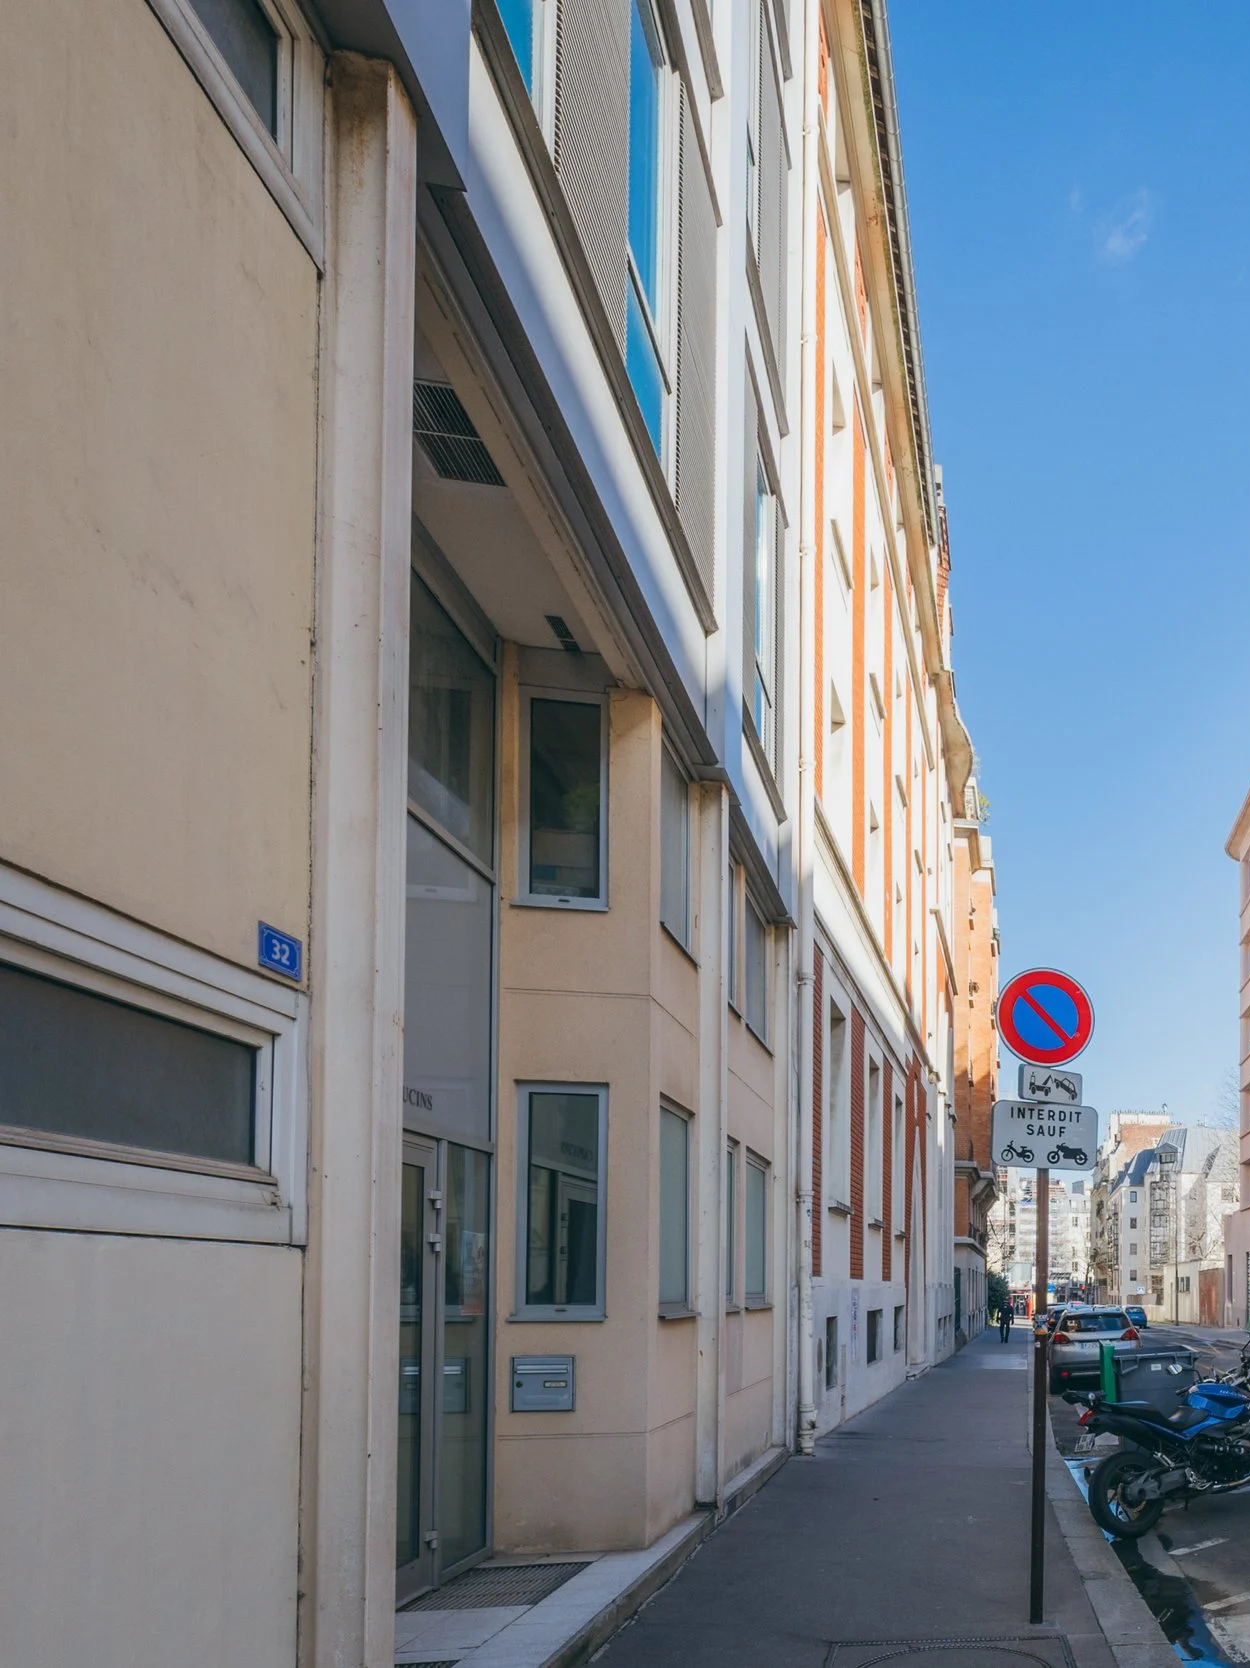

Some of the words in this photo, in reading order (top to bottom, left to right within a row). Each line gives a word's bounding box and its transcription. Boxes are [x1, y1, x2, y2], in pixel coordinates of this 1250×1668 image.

[271, 938, 290, 966] 32
[1010, 1106, 1082, 1123] INTERDIT
[1026, 1123, 1066, 1138] SAUF
